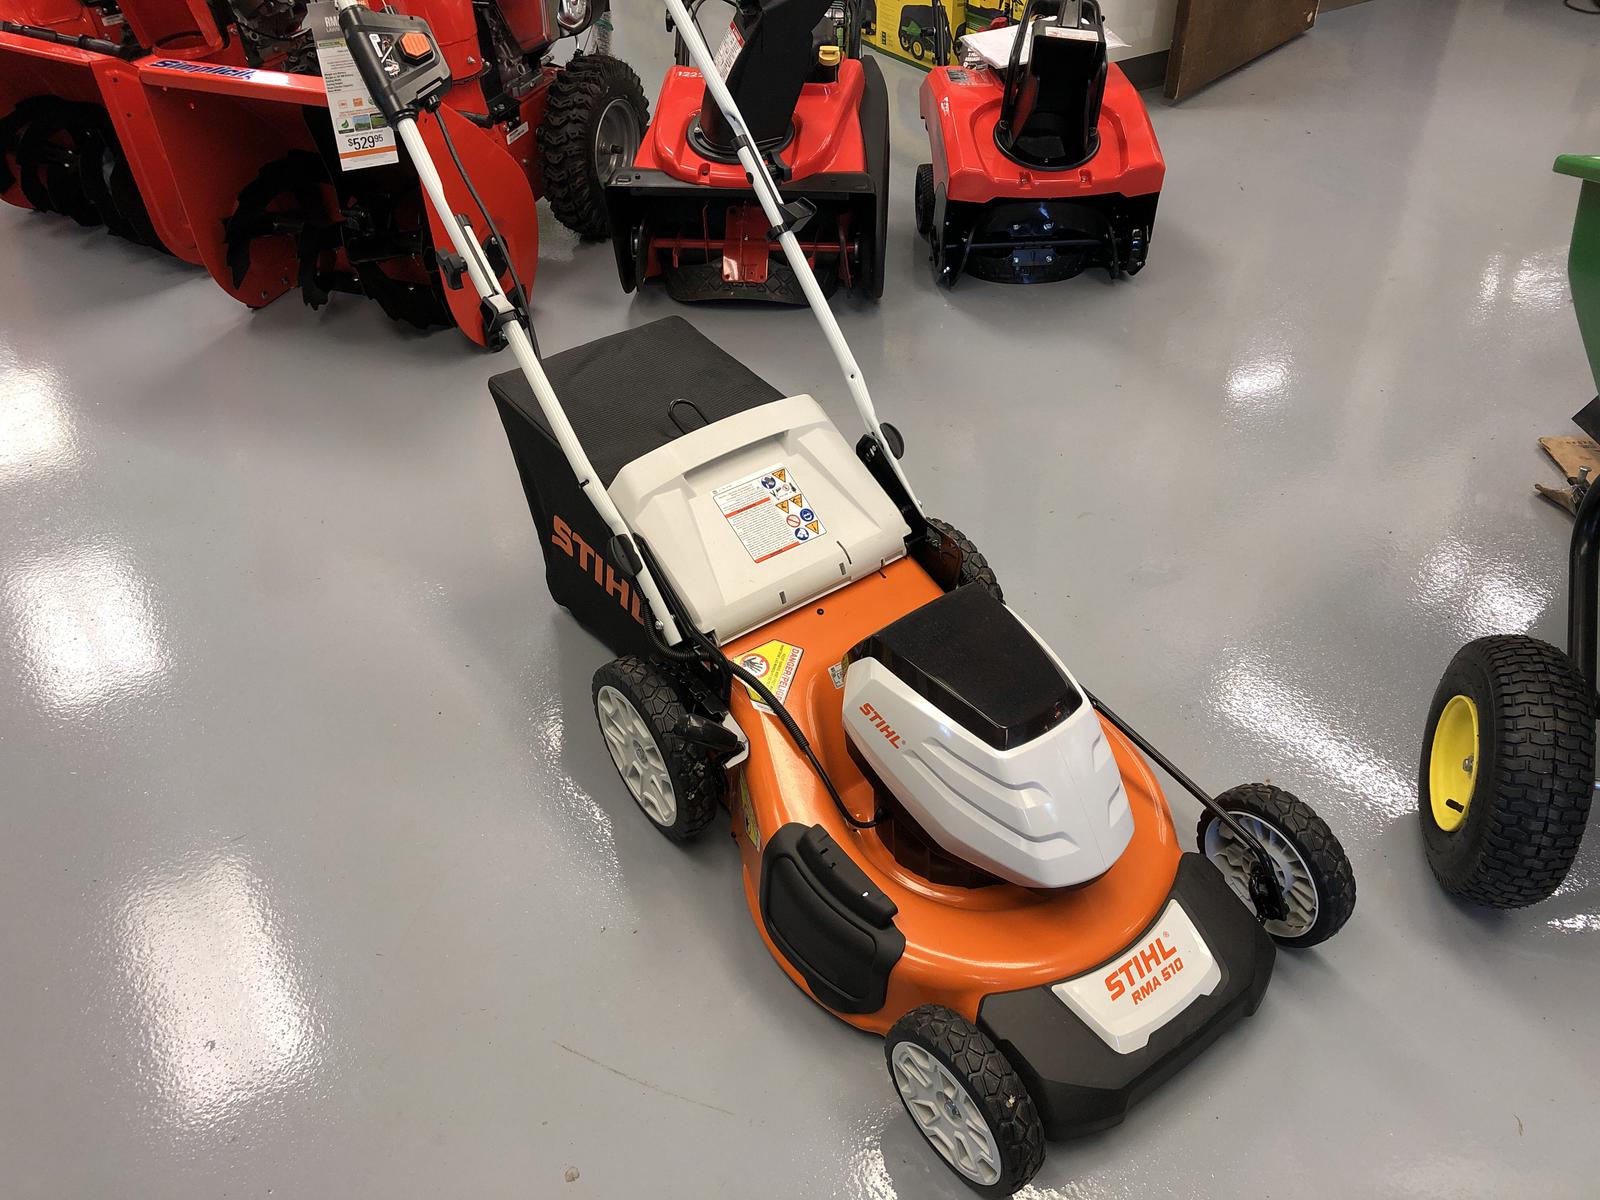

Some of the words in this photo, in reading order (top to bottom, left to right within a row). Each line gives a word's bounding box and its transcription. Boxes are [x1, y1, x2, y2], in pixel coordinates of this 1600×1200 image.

[551, 514, 646, 626] STIHL
[775, 648, 800, 701] DANGER/PELIGR
[859, 702, 901, 749] STIHL
[1104, 937, 1178, 1002] STIHL
[1131, 975, 1162, 1006] RMA
[1160, 957, 1184, 982] 510
